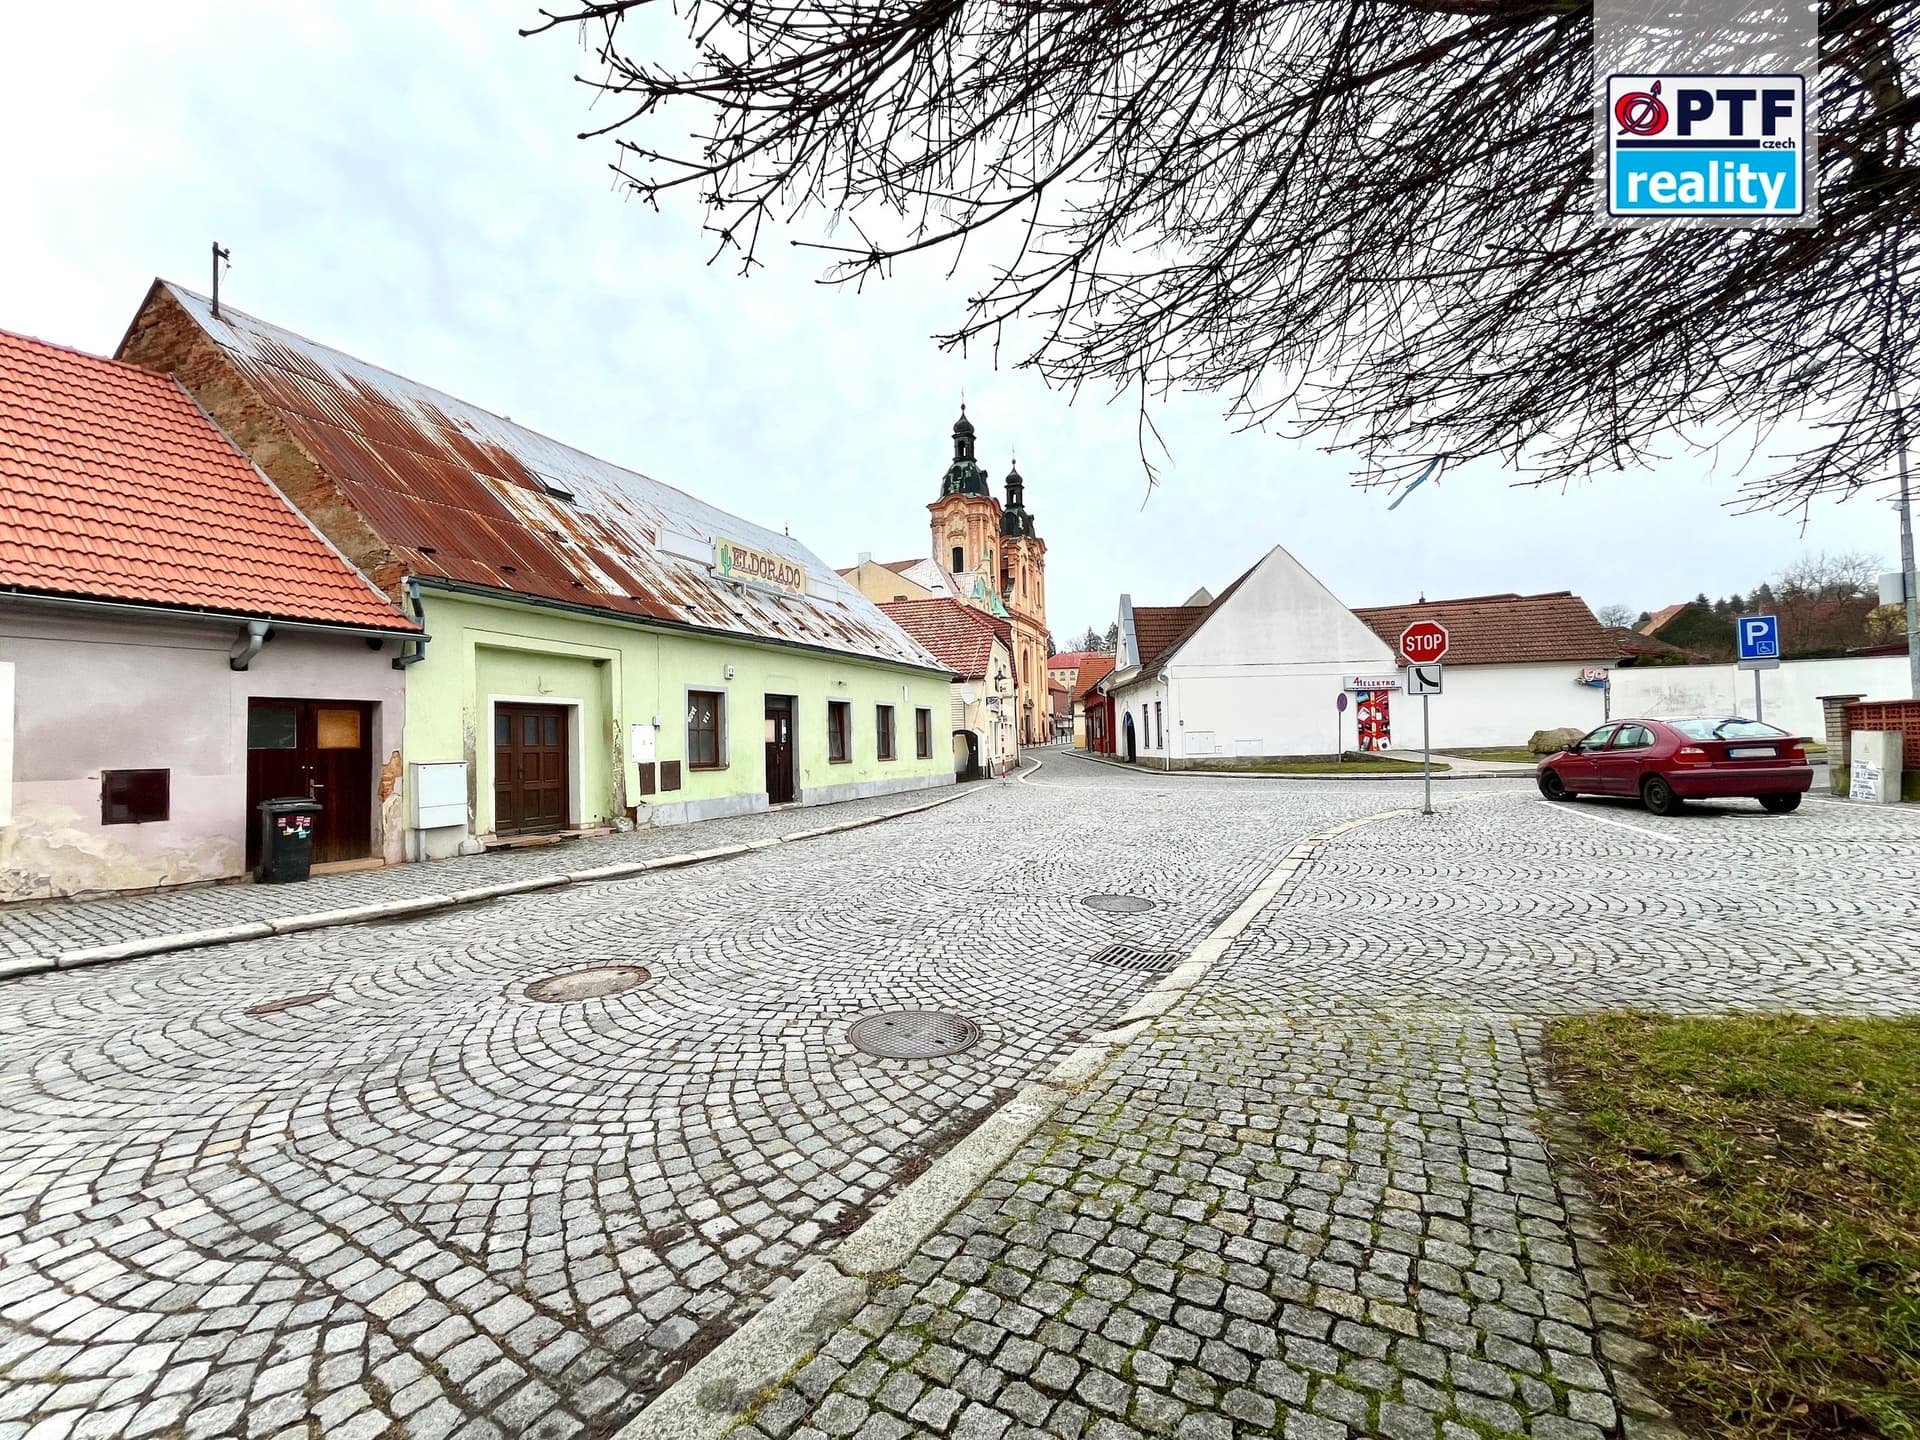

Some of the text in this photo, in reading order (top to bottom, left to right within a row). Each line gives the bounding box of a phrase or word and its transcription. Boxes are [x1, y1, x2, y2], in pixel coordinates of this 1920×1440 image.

[731, 546, 801, 589] ELDORADO
[1406, 634, 1442, 651] STOP
[1746, 621, 1769, 646] P
